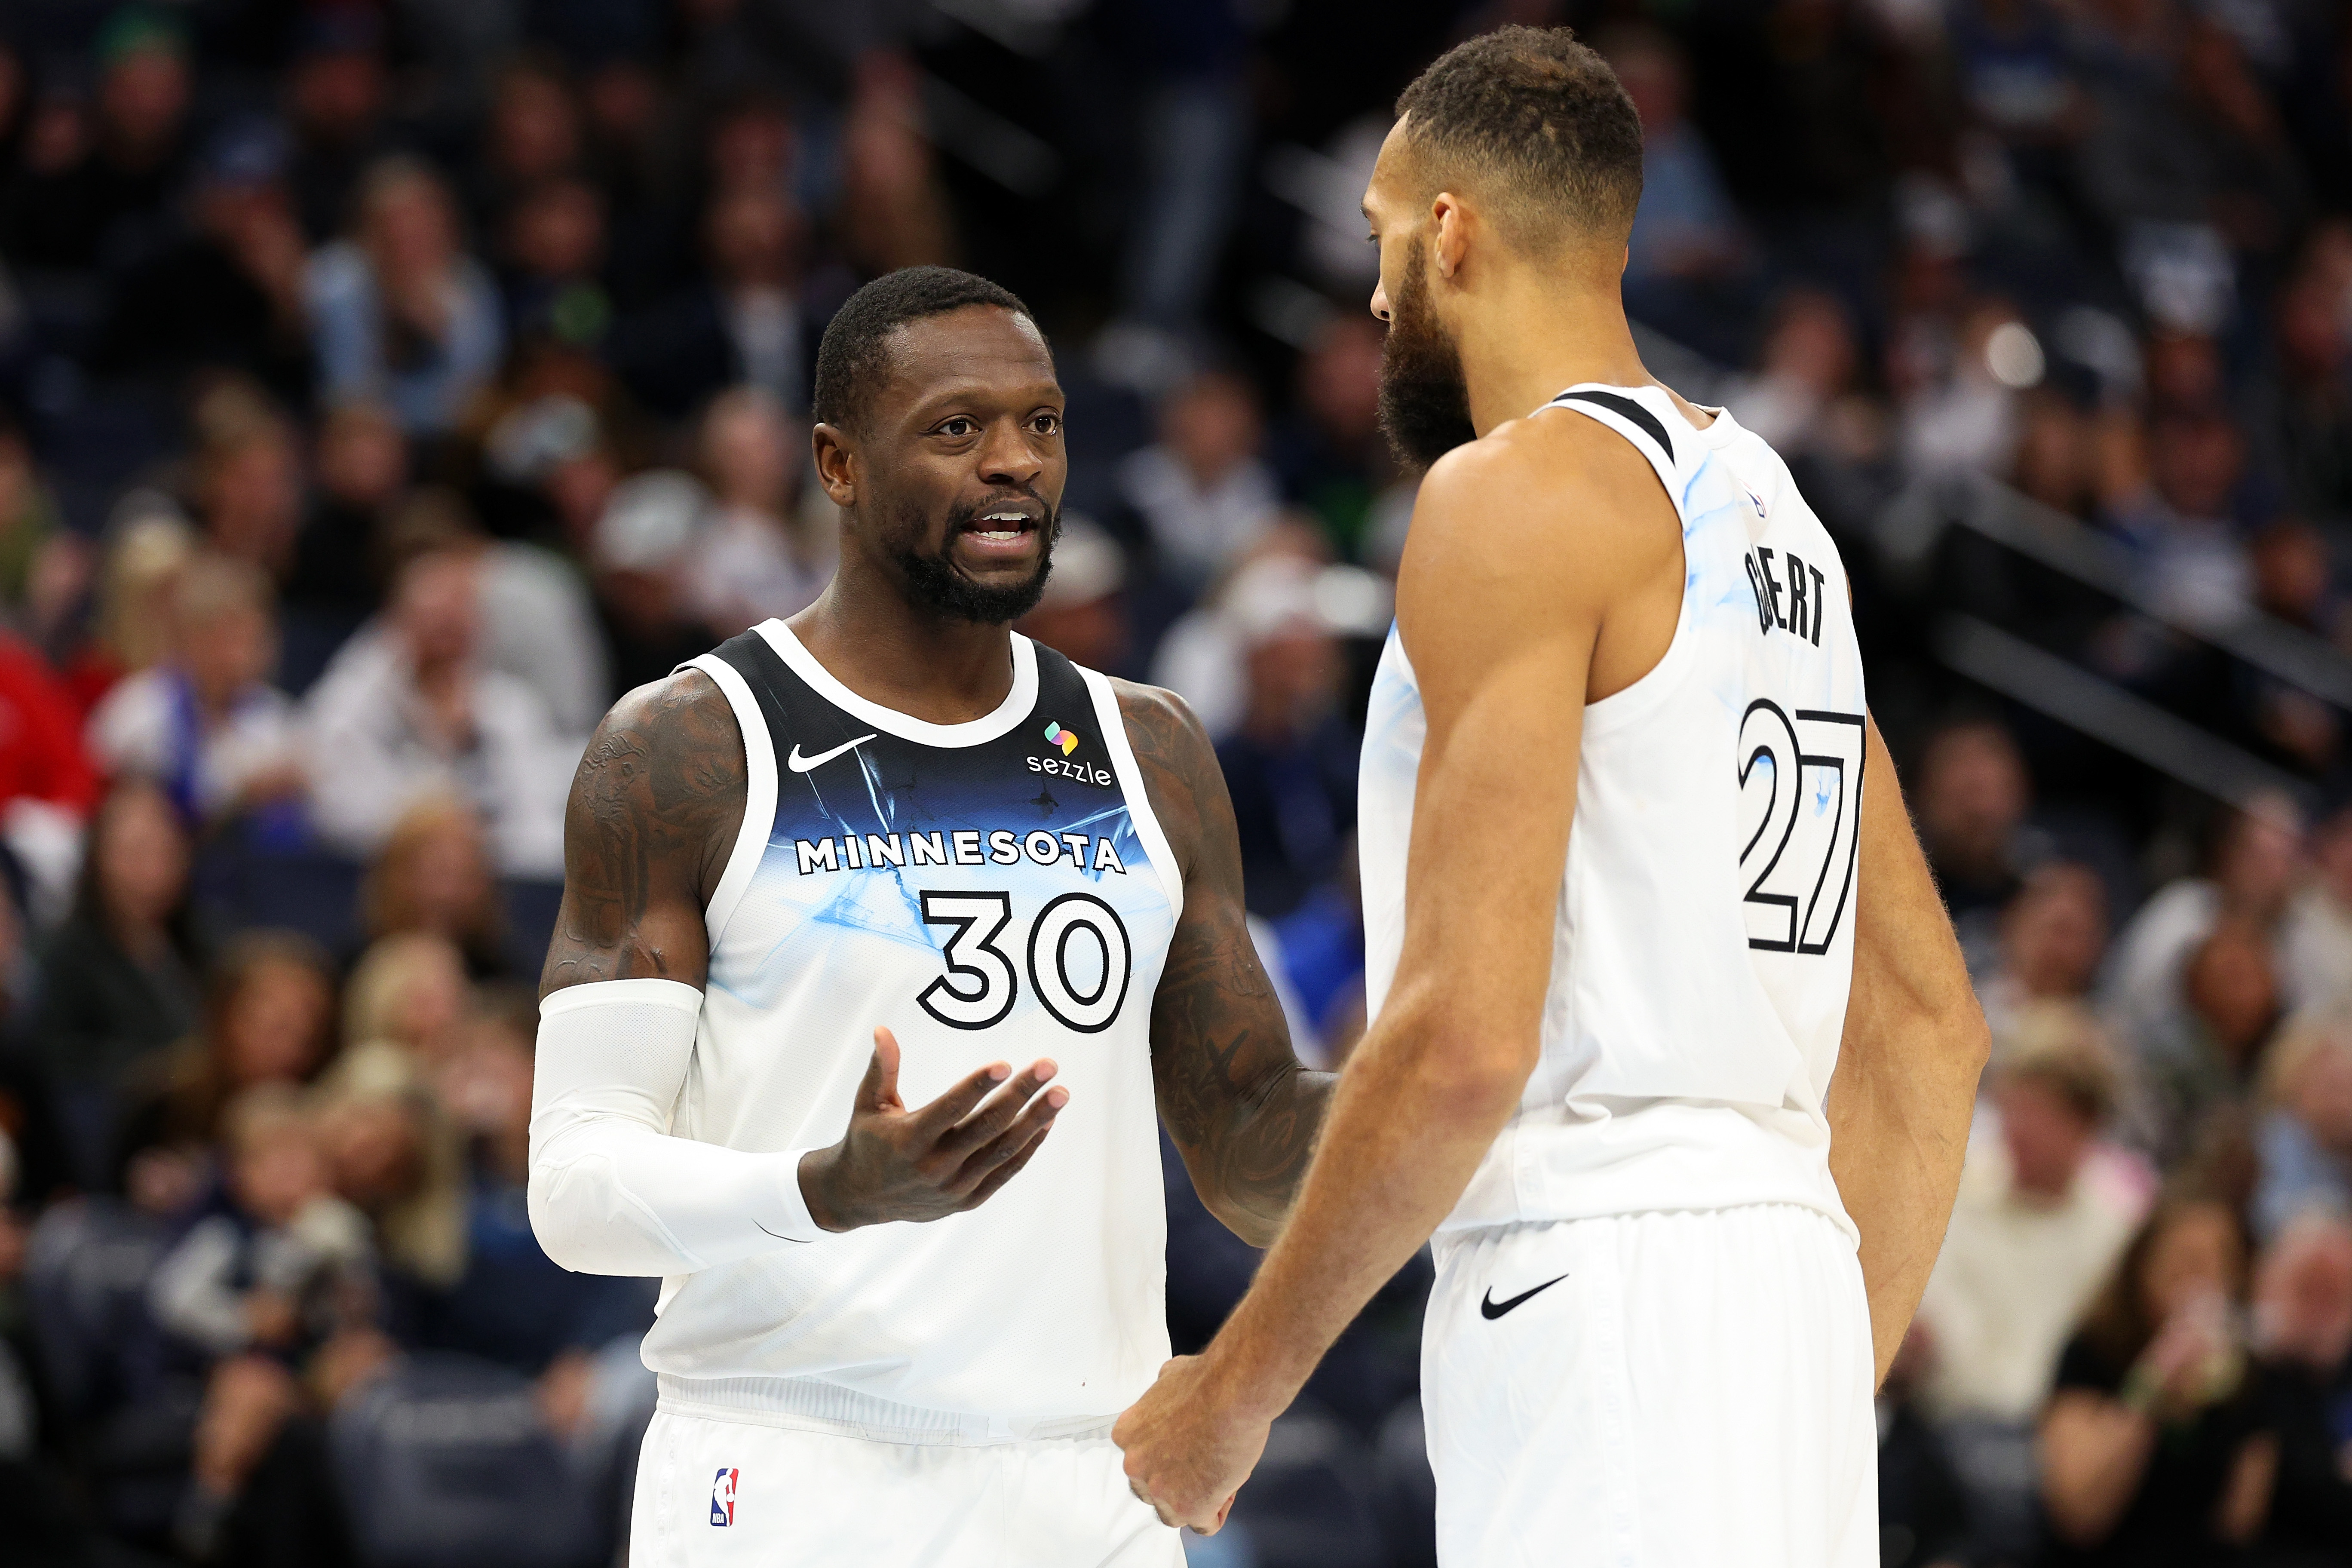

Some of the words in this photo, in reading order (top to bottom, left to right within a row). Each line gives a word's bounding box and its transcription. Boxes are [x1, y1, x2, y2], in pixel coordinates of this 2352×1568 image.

[1027, 755, 1112, 786] sezzle
[1739, 699, 1866, 955] 27
[794, 829, 1127, 876] MINNESOTA
[916, 890, 1132, 1034] 30
[712, 1513, 724, 1524] NBA
